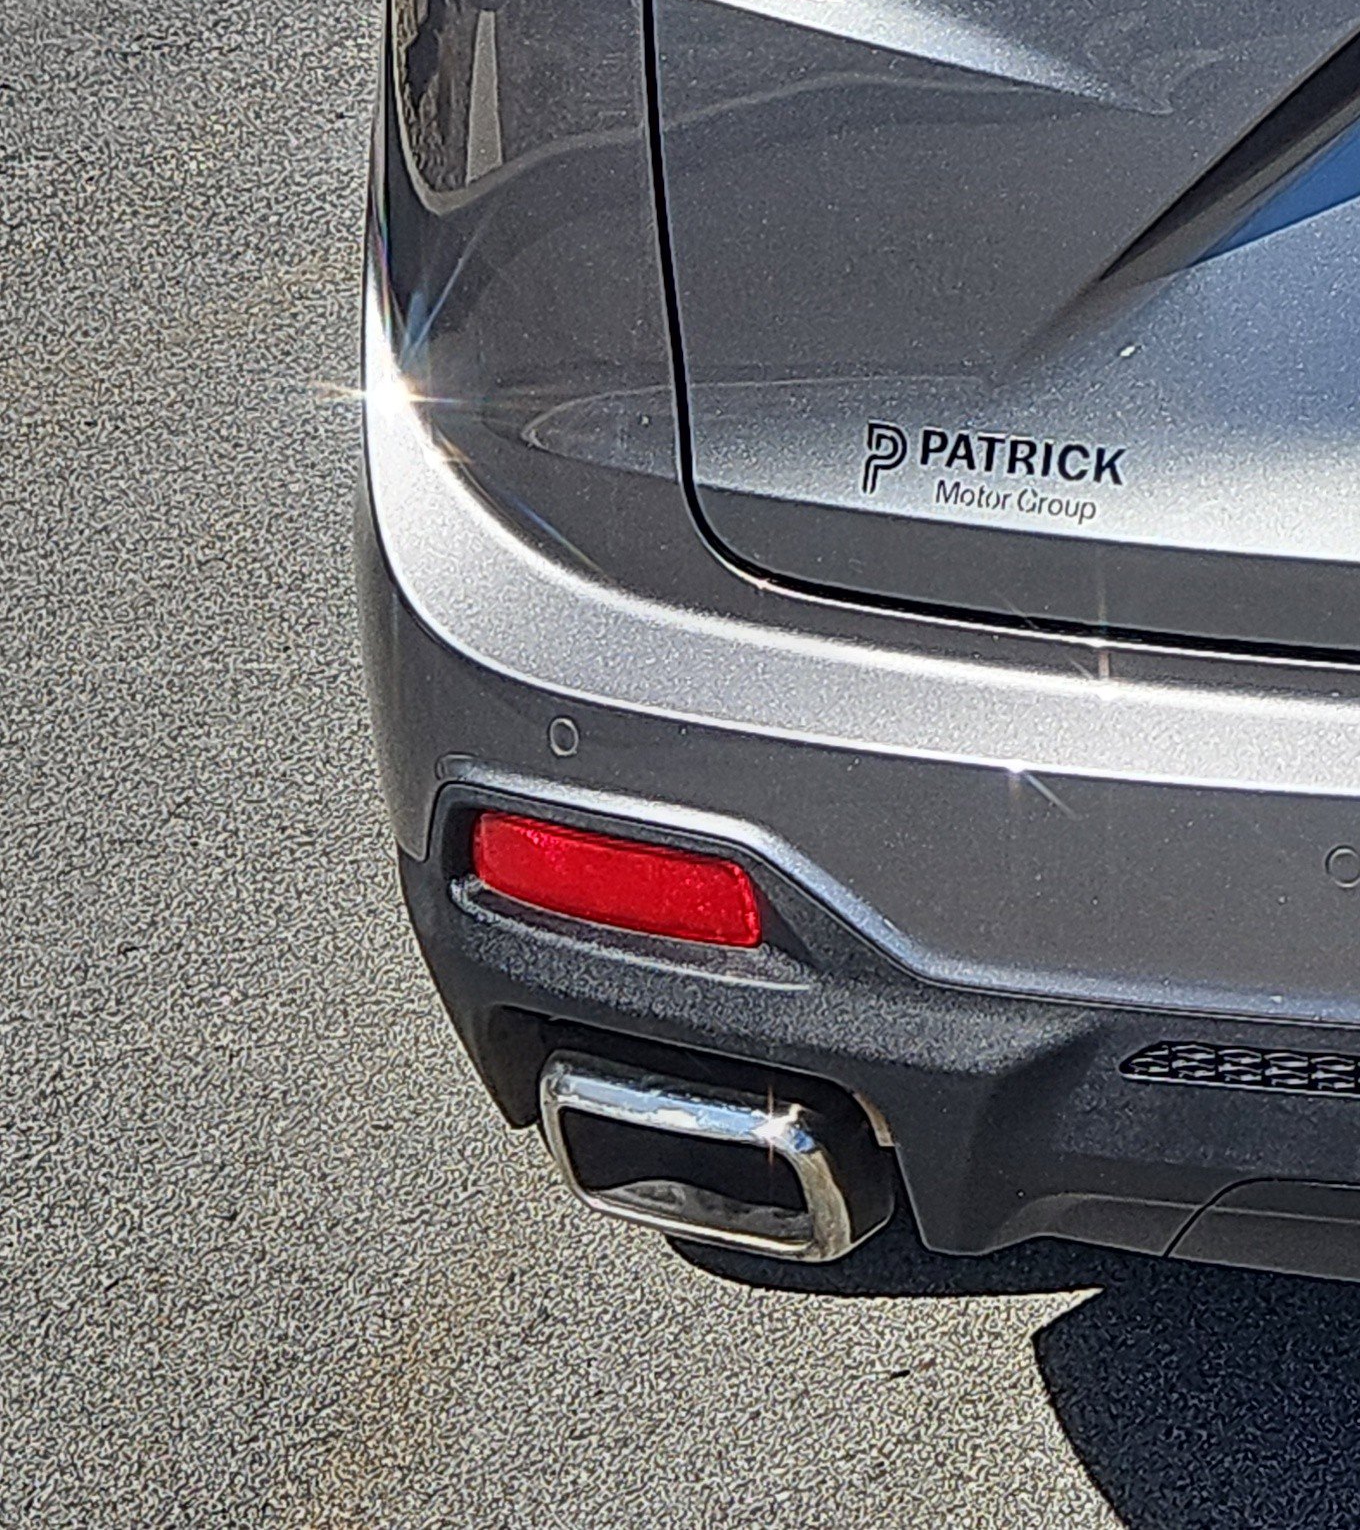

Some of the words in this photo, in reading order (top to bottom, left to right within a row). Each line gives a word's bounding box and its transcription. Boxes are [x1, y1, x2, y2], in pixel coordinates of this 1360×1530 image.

[920, 429, 1126, 486] PATRICK
[935, 479, 1012, 511] Motor
[1017, 488, 1097, 525] Group
